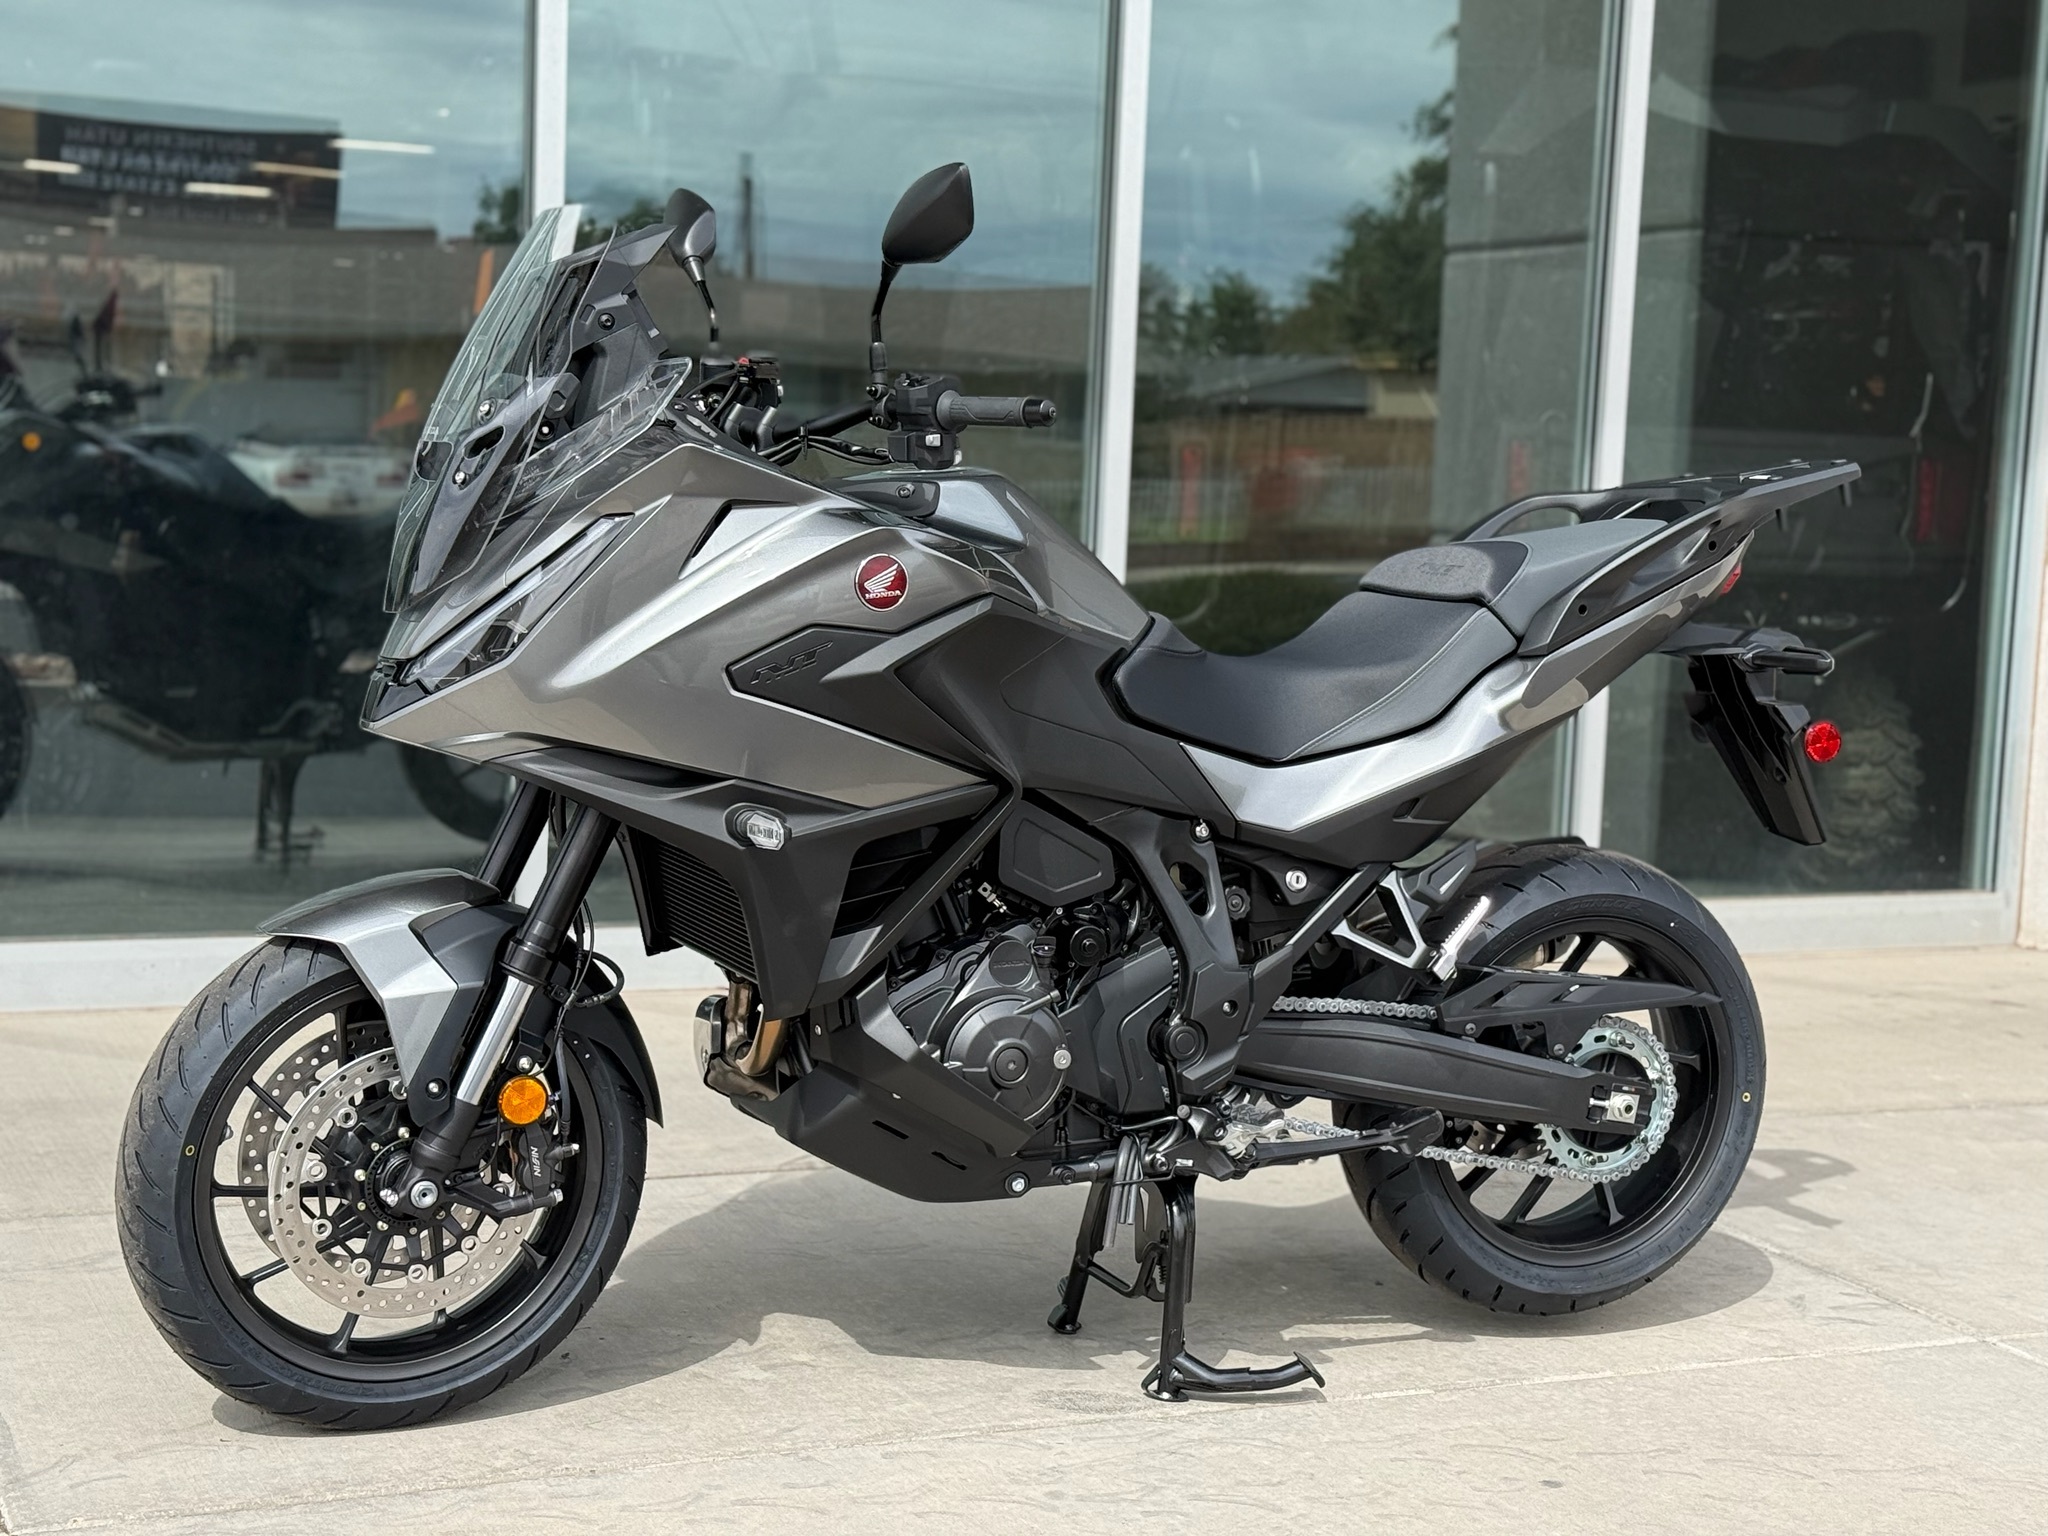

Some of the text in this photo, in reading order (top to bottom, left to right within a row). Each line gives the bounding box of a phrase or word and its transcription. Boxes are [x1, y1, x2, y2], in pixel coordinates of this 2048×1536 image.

[864, 590, 902, 600] HONDA
[992, 960, 1030, 969] HONDA
[530, 1145, 543, 1178] NISSIN
